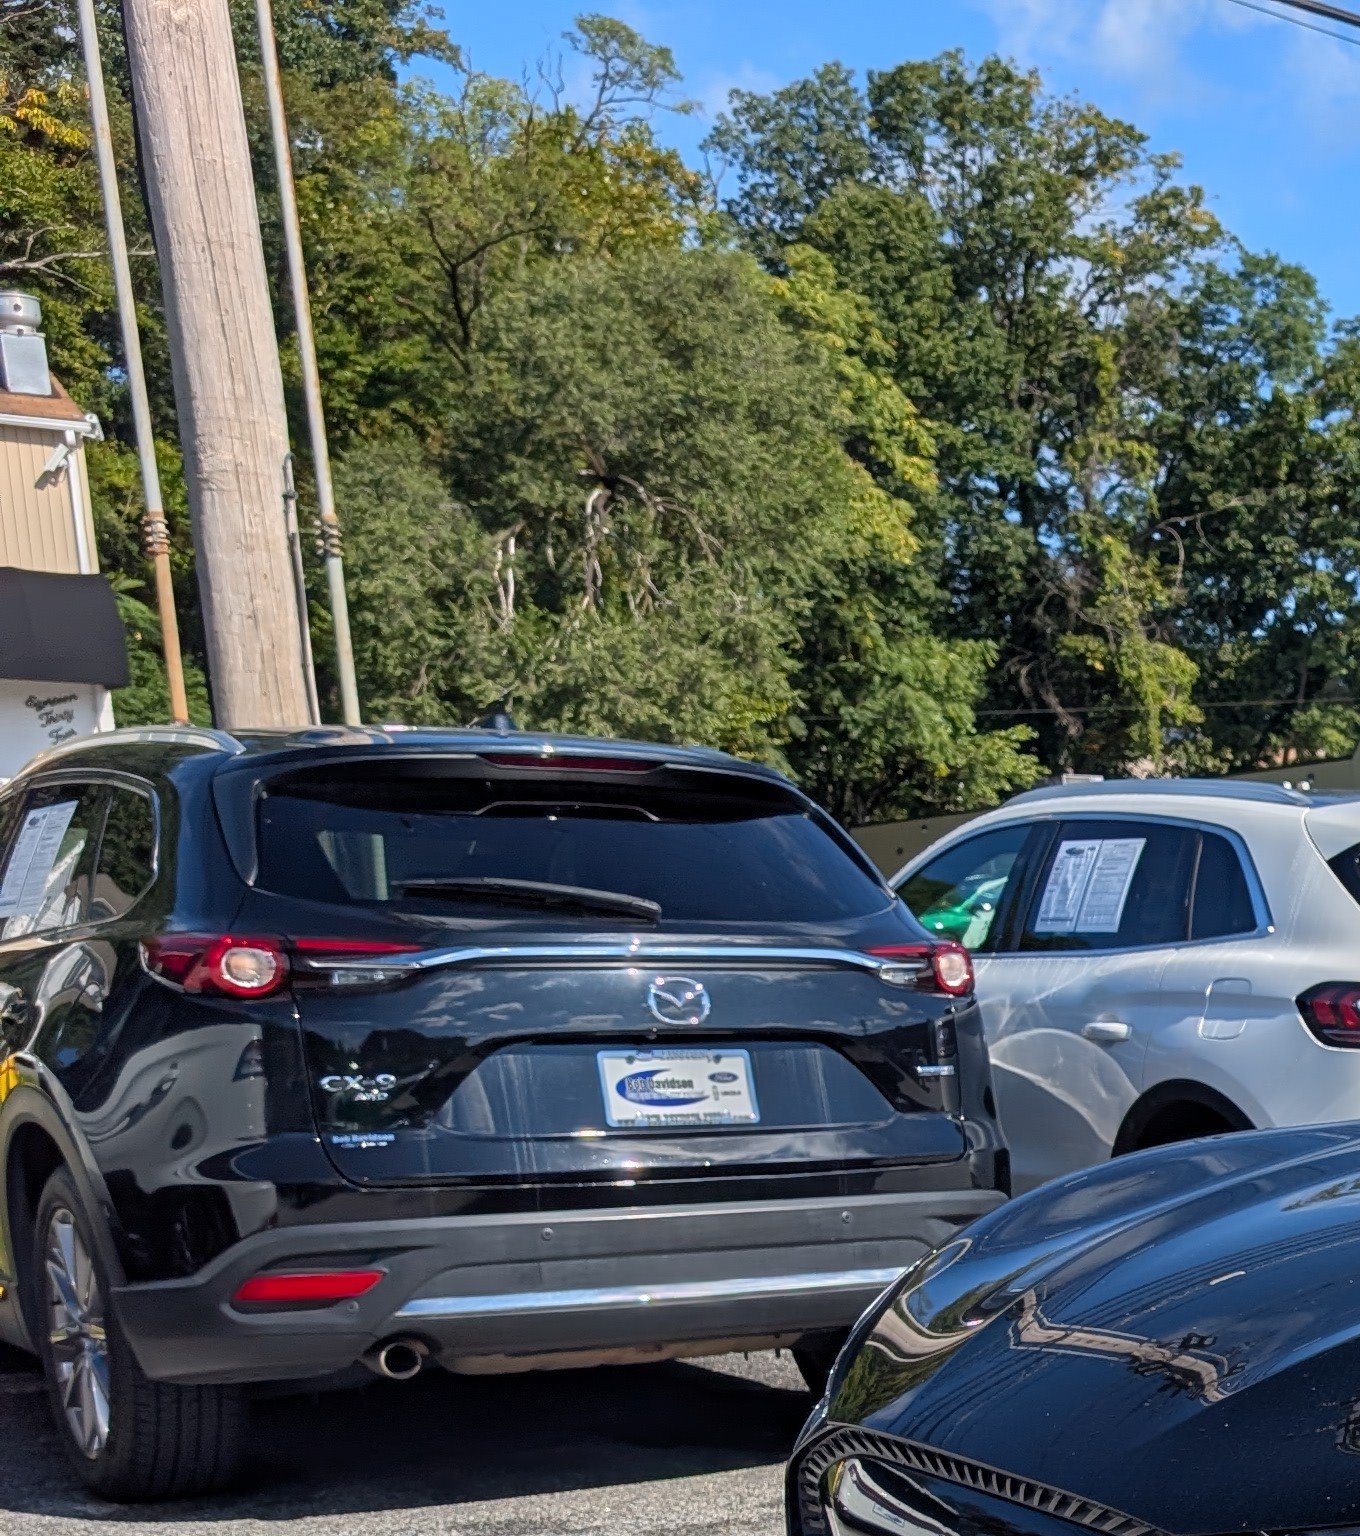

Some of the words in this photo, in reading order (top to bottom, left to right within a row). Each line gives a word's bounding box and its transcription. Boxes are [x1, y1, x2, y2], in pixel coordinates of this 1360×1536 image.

[320, 1074, 397, 1092] CX-9
[626, 1077, 650, 1090] Bob
[650, 1077, 694, 1090] Davidson
